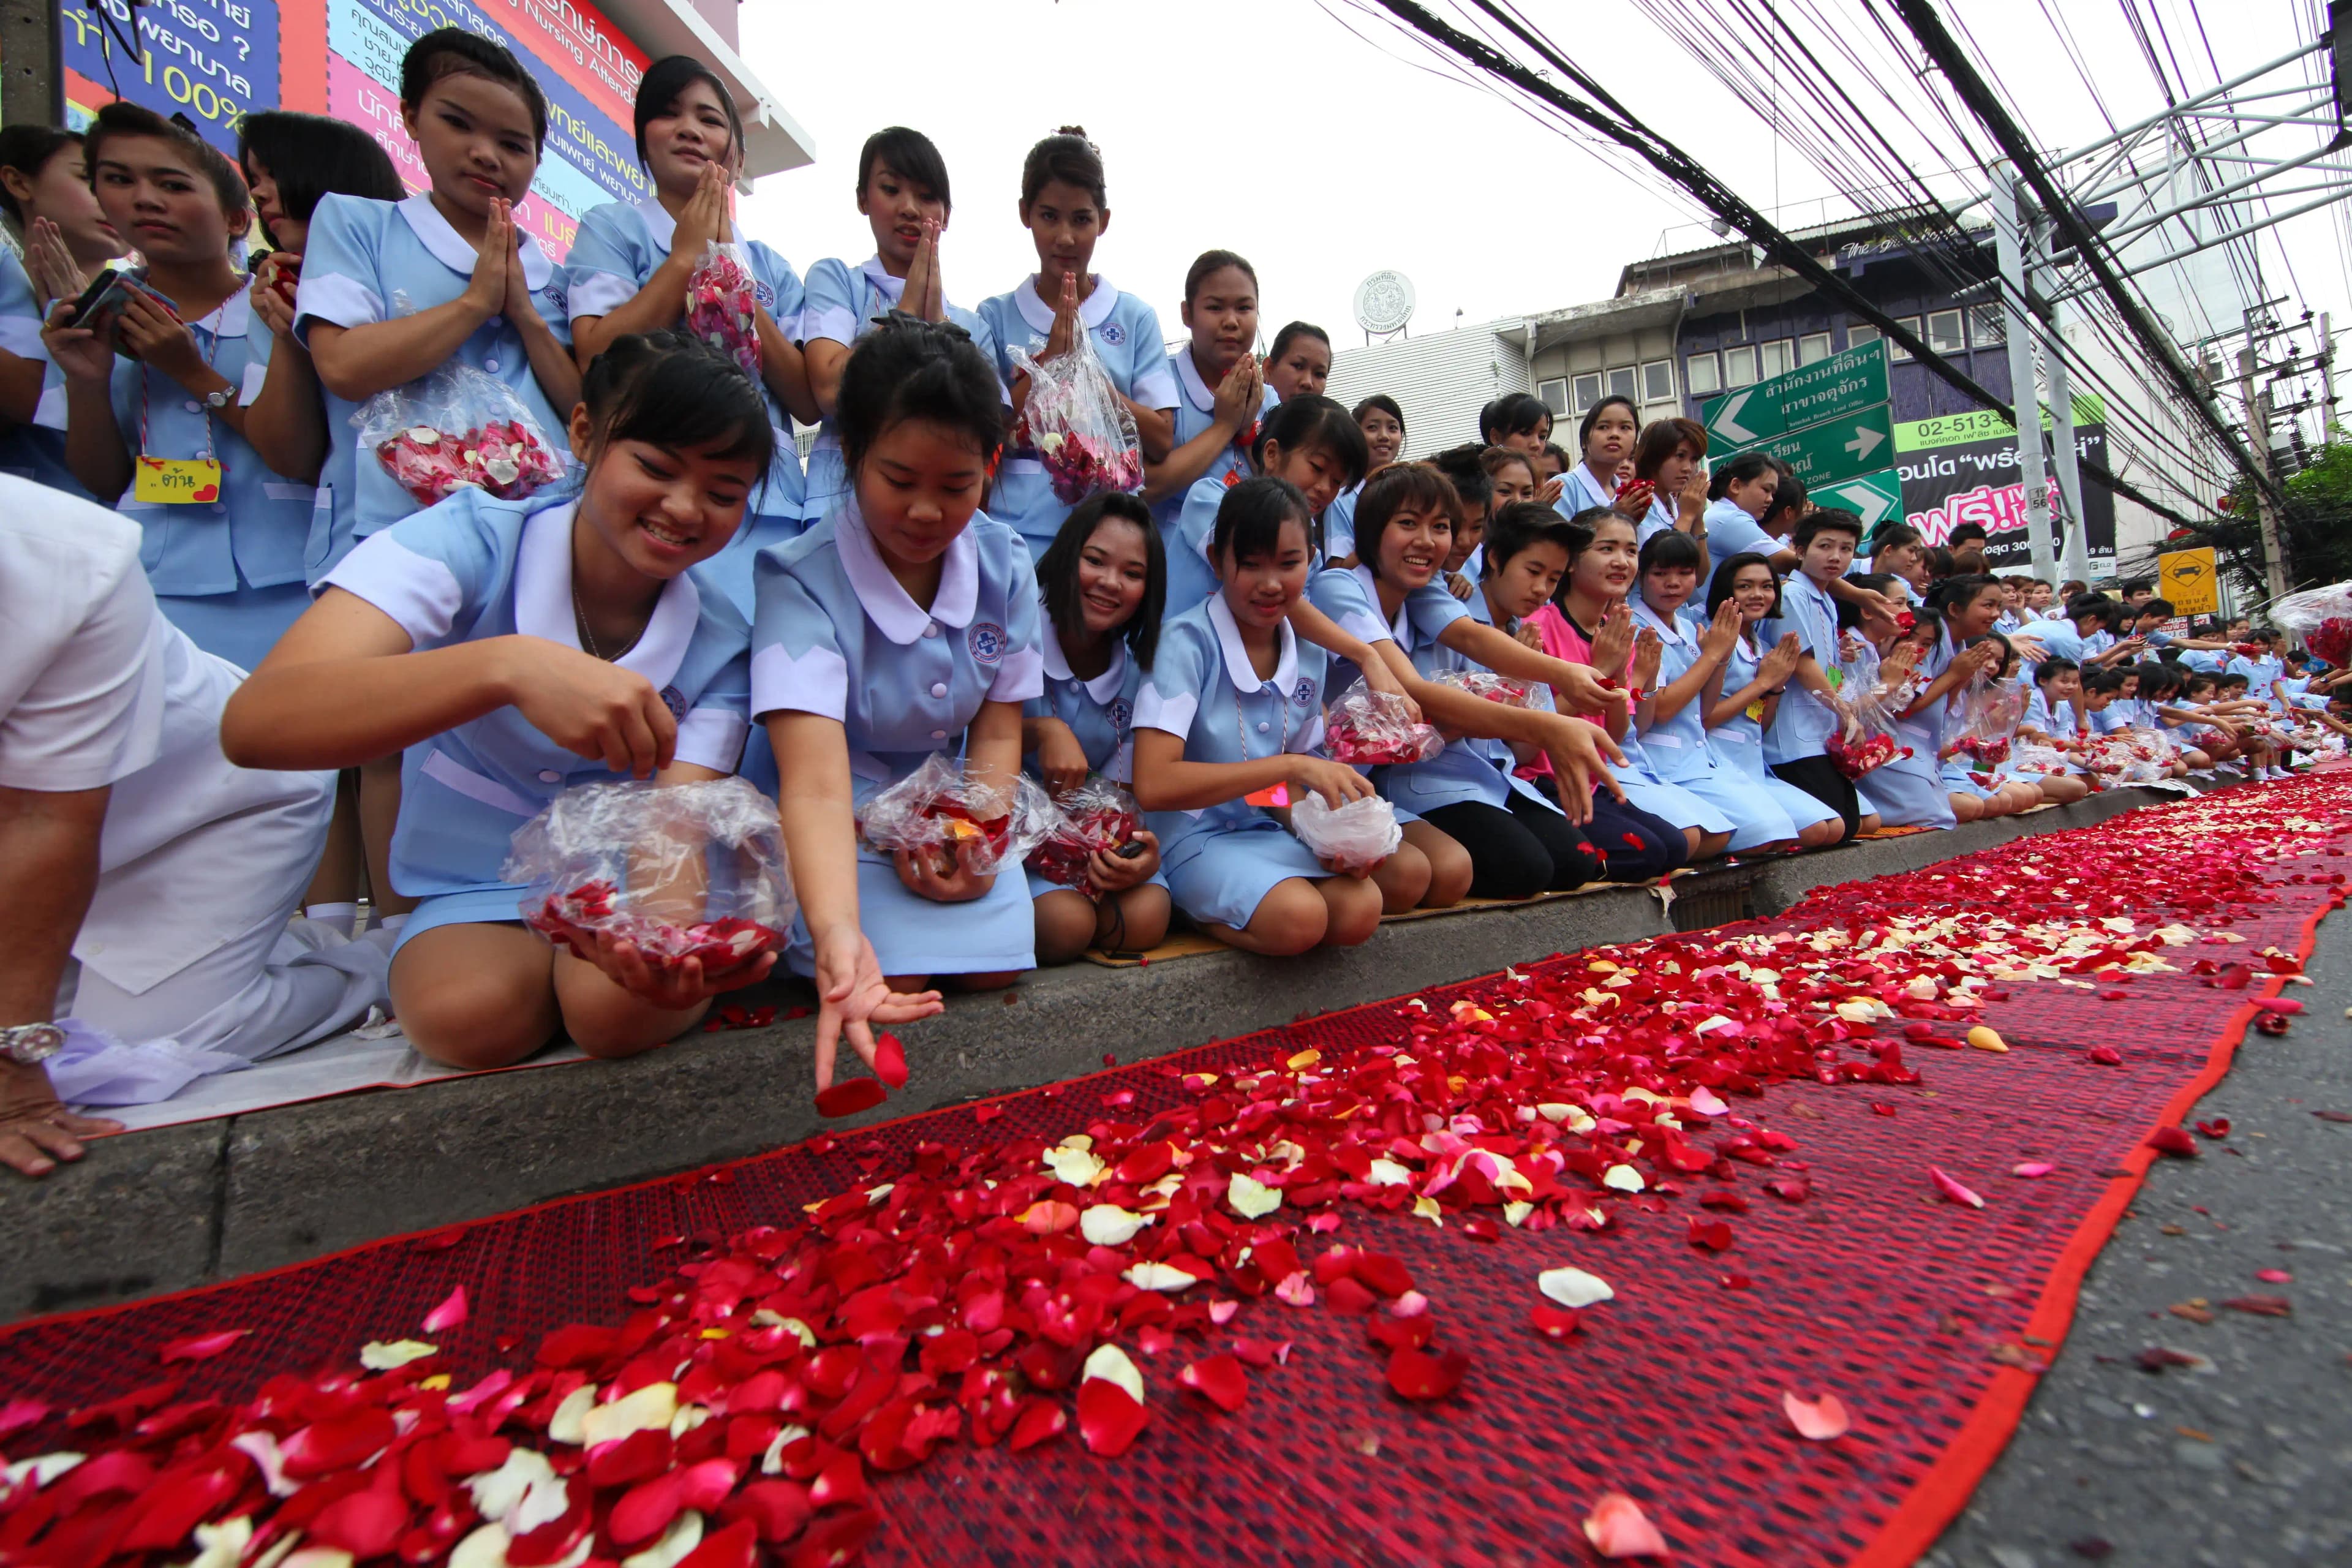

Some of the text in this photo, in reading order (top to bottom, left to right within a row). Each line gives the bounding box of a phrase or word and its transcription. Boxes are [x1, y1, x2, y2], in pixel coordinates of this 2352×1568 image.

[352, 9, 410, 57] คุณสมบั
[525, 0, 583, 66] Nursing
[138, 15, 251, 99] พยาบาล
[1781, 377, 1868, 415] สาขาจตุจักร
[1813, 410, 1831, 420] Branch
[1848, 399, 1864, 408] Office
[1807, 471, 1831, 484] ZONE
[1887, 455, 1956, 482] อนโด
[2034, 499, 2046, 508] 56
